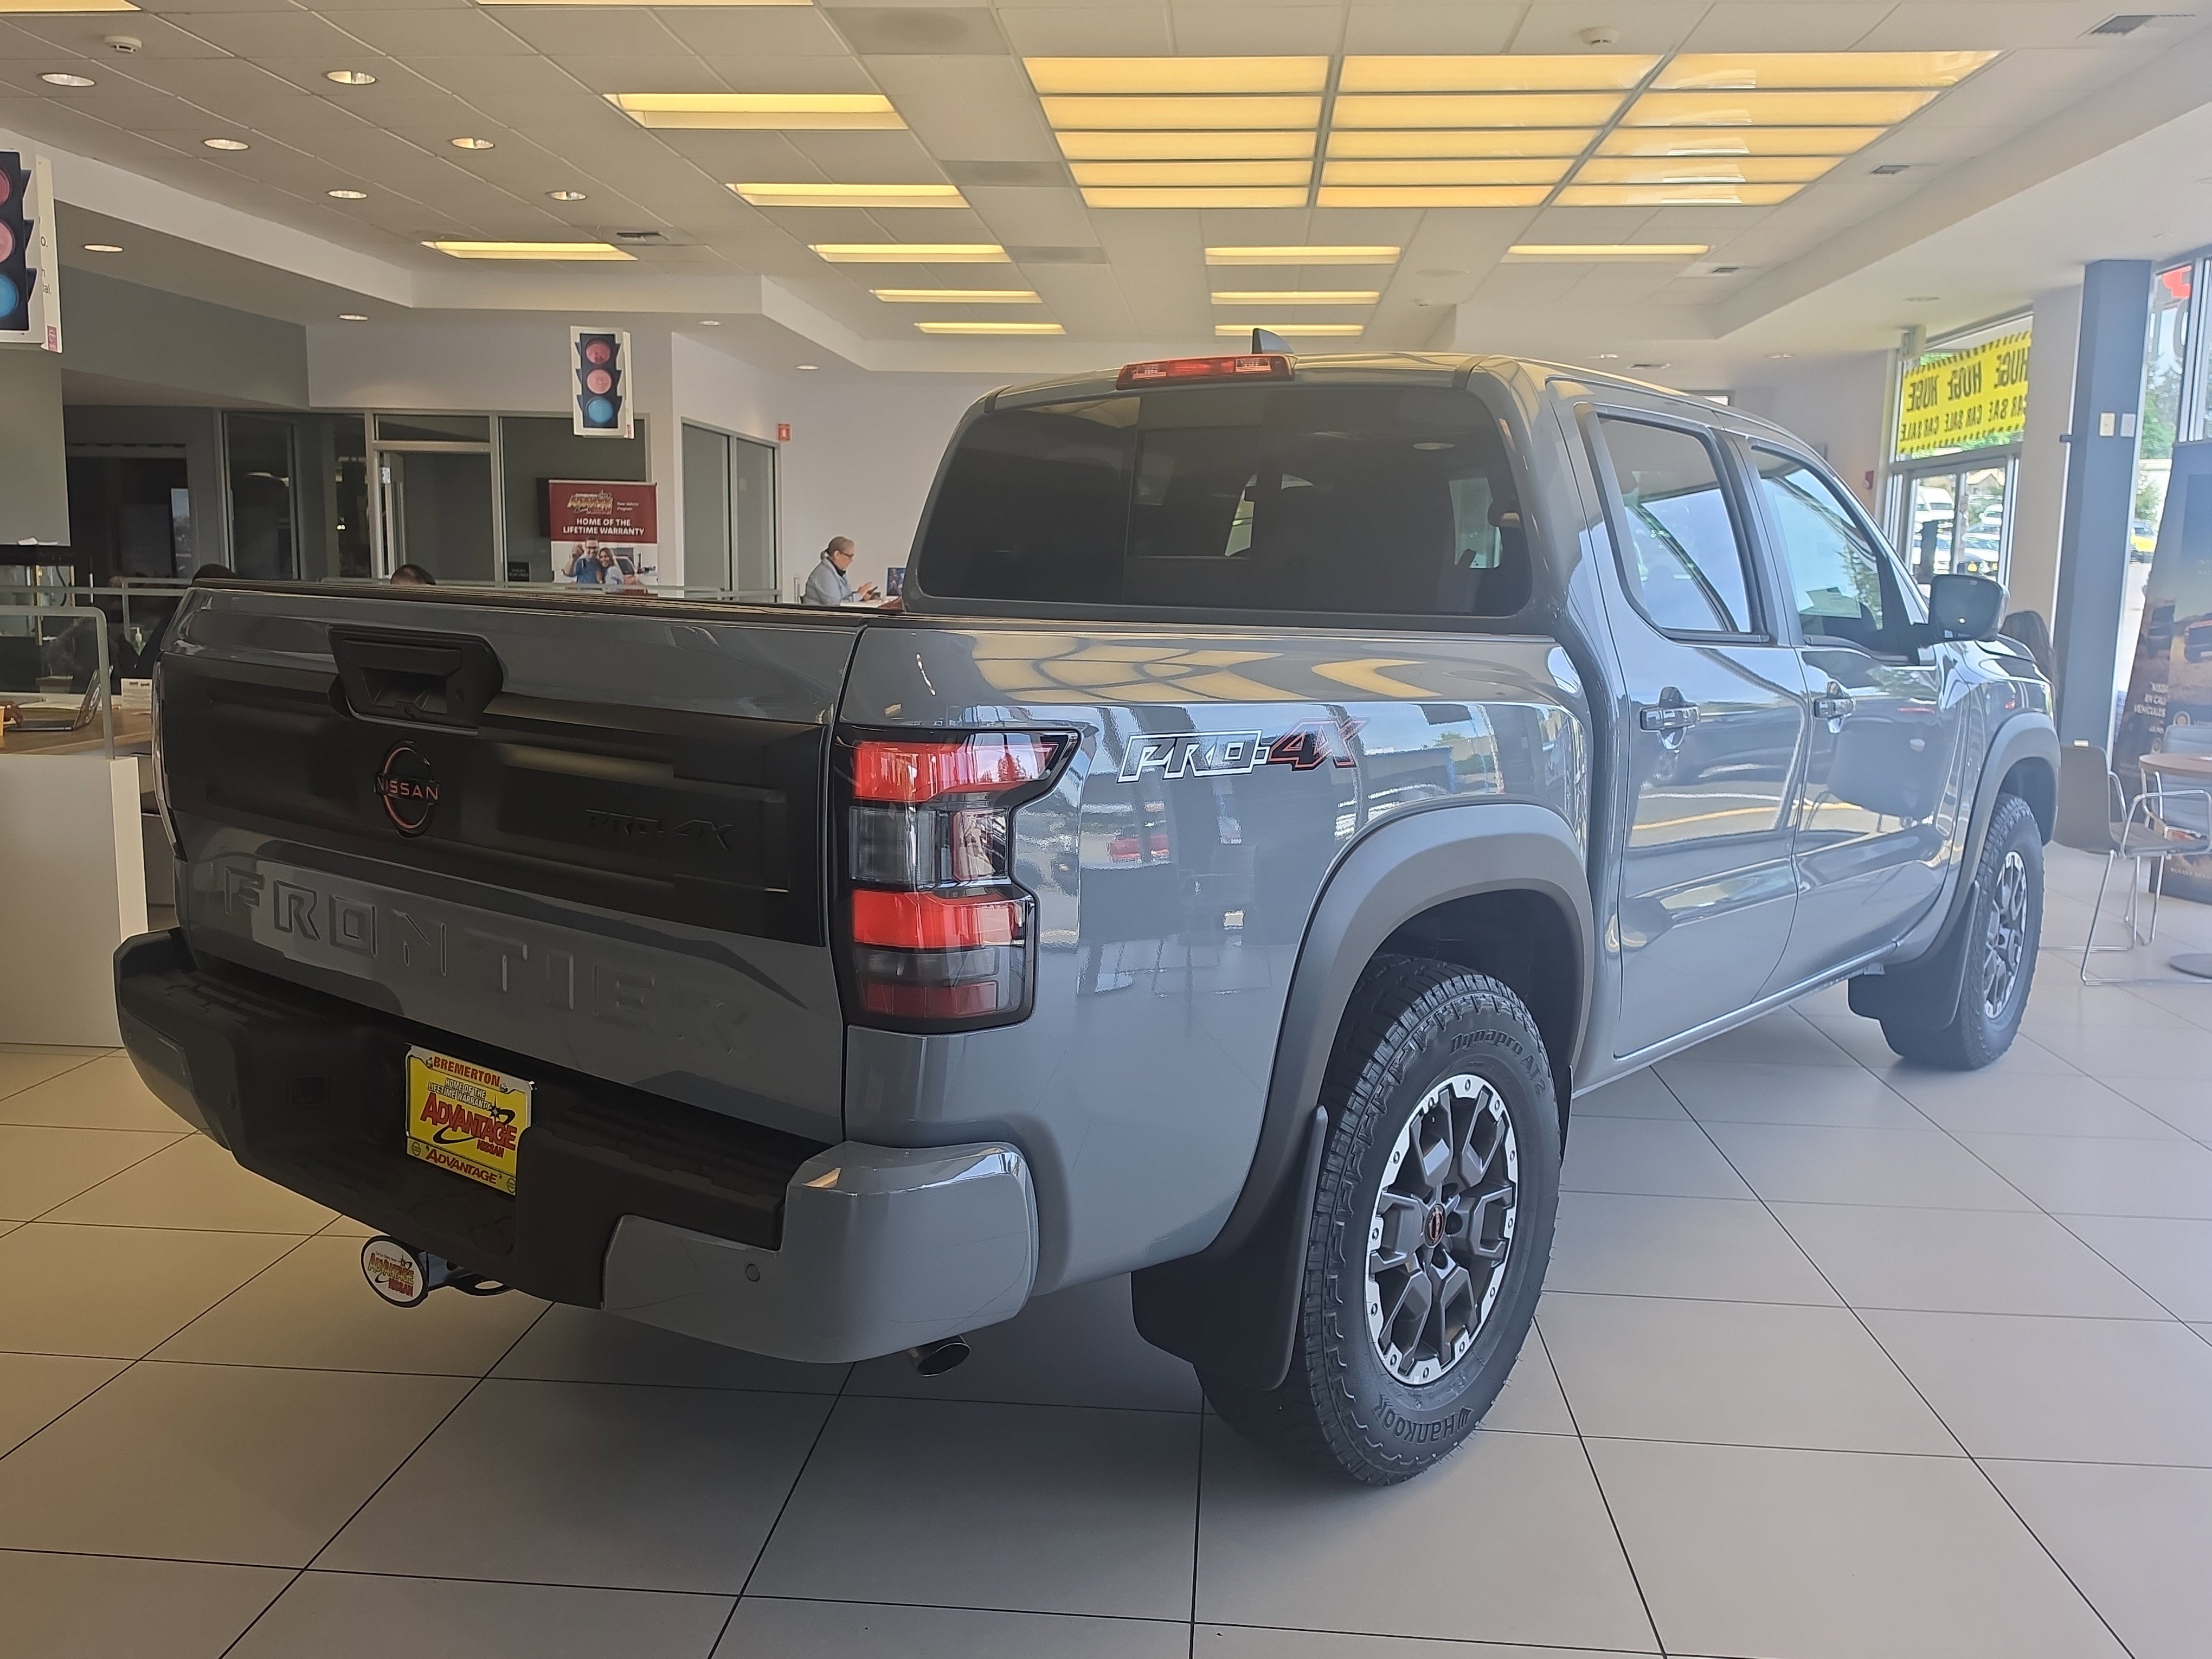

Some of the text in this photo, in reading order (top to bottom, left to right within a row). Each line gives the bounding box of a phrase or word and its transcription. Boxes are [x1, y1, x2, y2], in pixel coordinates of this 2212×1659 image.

[563, 526, 645, 536] LIFETIME WARRANTY
[1116, 717, 1370, 783] PRO-4X
[377, 775, 440, 801] NISSAN
[222, 864, 753, 1061] FRONTIER
[1449, 1029, 1524, 1057] Dynapro
[433, 1056, 500, 1087] BREMERTON
[428, 1082, 492, 1110] LIFETIME WARRANTY
[445, 1077, 486, 1099] HOME OF THE
[420, 1092, 518, 1150] ADVANTAGE
[477, 1139, 505, 1158] NISSAN
[368, 1252, 414, 1285] ADVANTAGE
[388, 1277, 414, 1297] NISSAN
[1371, 1391, 1456, 1445] Hankook
